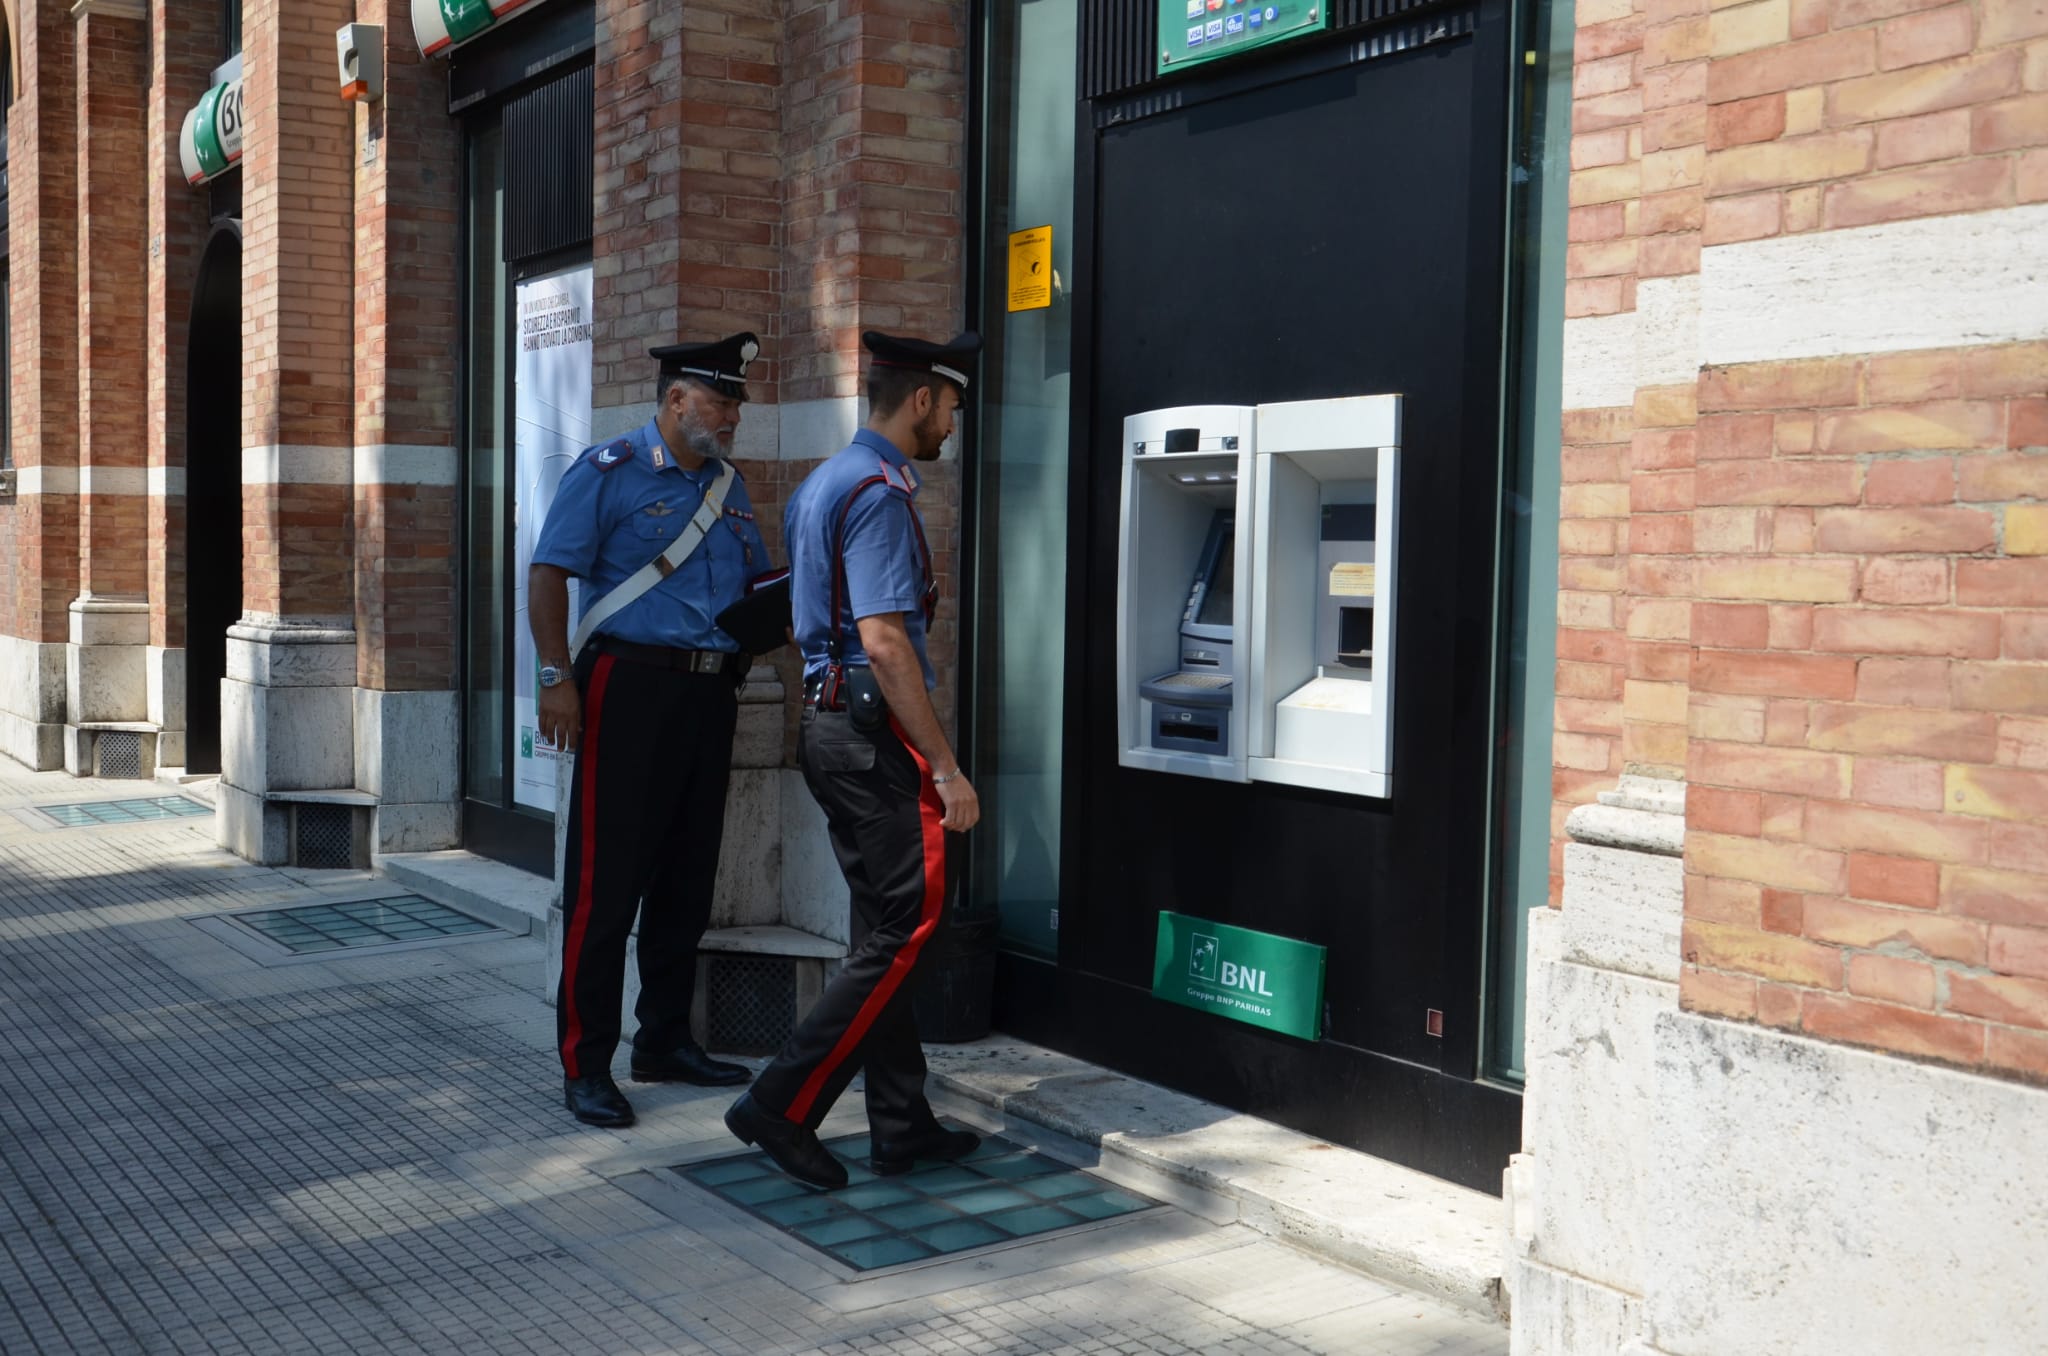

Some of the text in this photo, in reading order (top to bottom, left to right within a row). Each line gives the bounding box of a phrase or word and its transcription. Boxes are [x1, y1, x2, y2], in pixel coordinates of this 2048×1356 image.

[1208, 23, 1221, 33] VISA
[524, 313, 550, 335] SICUREZZA
[553, 307, 581, 328] RISPARMIO
[523, 334, 540, 352] HANNO
[540, 329, 561, 349] TROVATO
[1221, 961, 1273, 996] BNL
[1187, 987, 1272, 1016] Gruppo BNP PARIBAS
